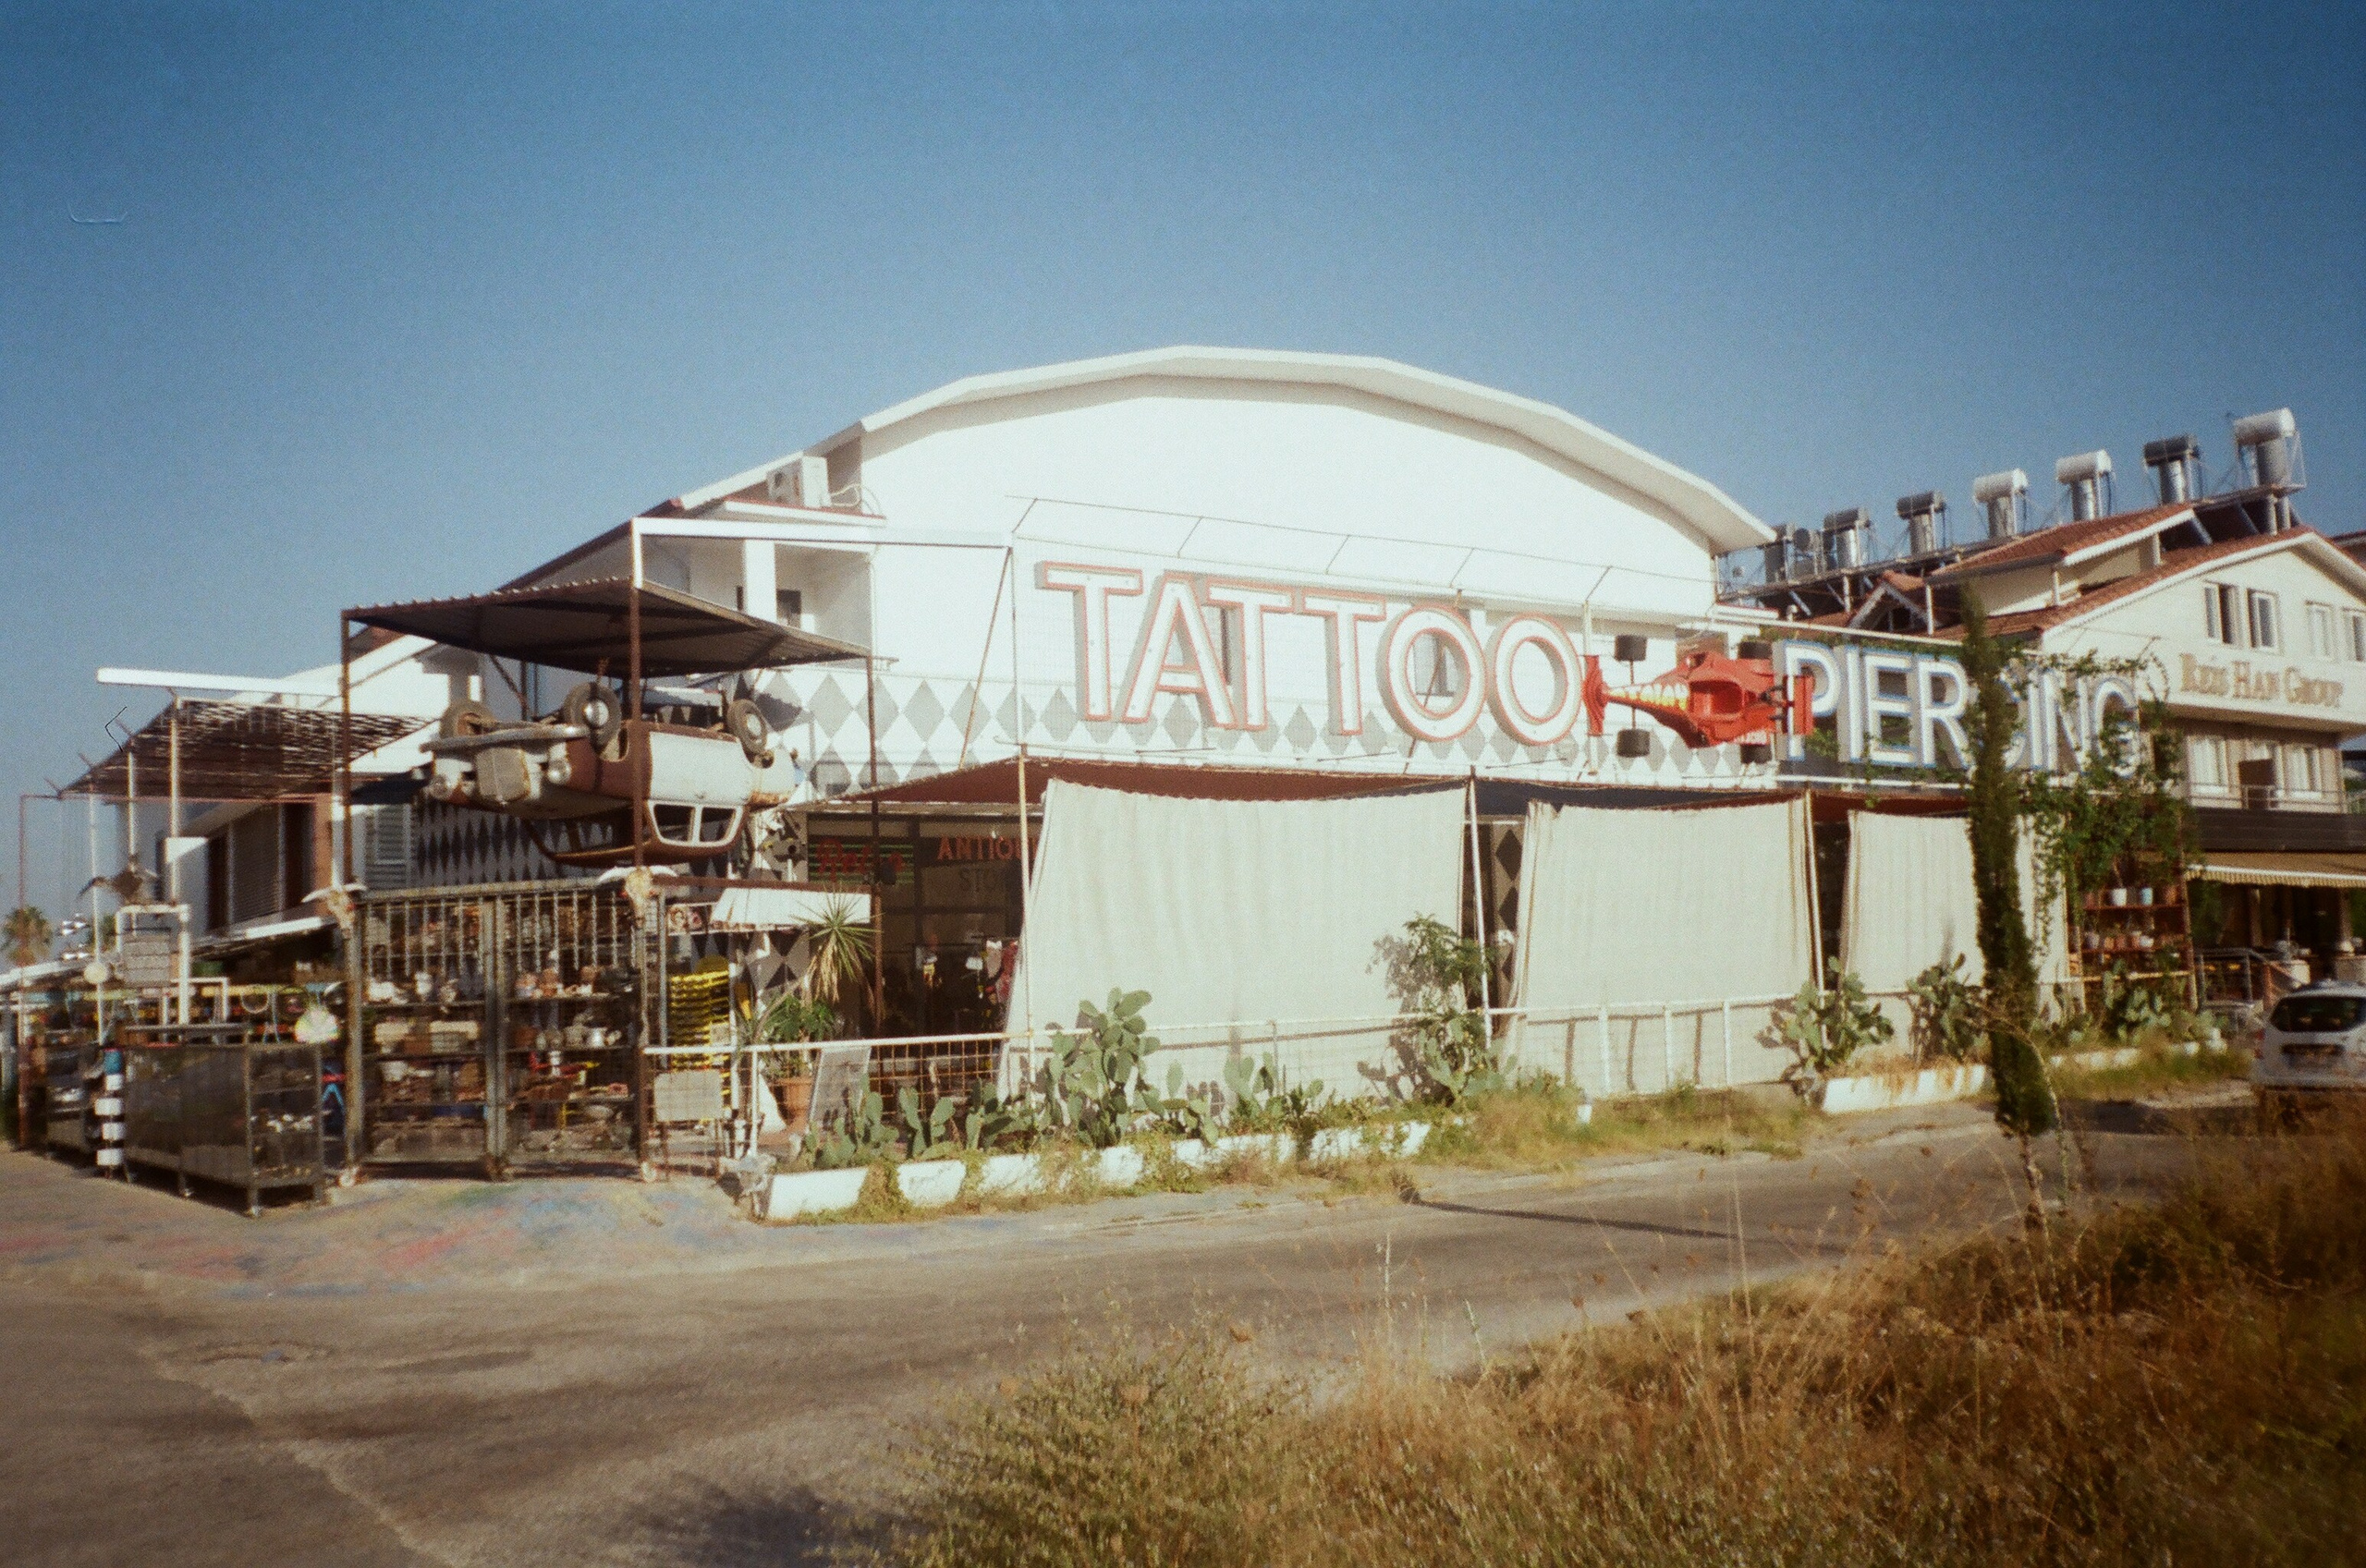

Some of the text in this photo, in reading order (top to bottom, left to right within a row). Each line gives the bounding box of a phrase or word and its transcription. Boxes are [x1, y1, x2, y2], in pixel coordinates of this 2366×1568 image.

[1036, 561, 1583, 747] TATTOO
[816, 838, 907, 882] Reto
[936, 835, 1037, 861] ANTIQ
